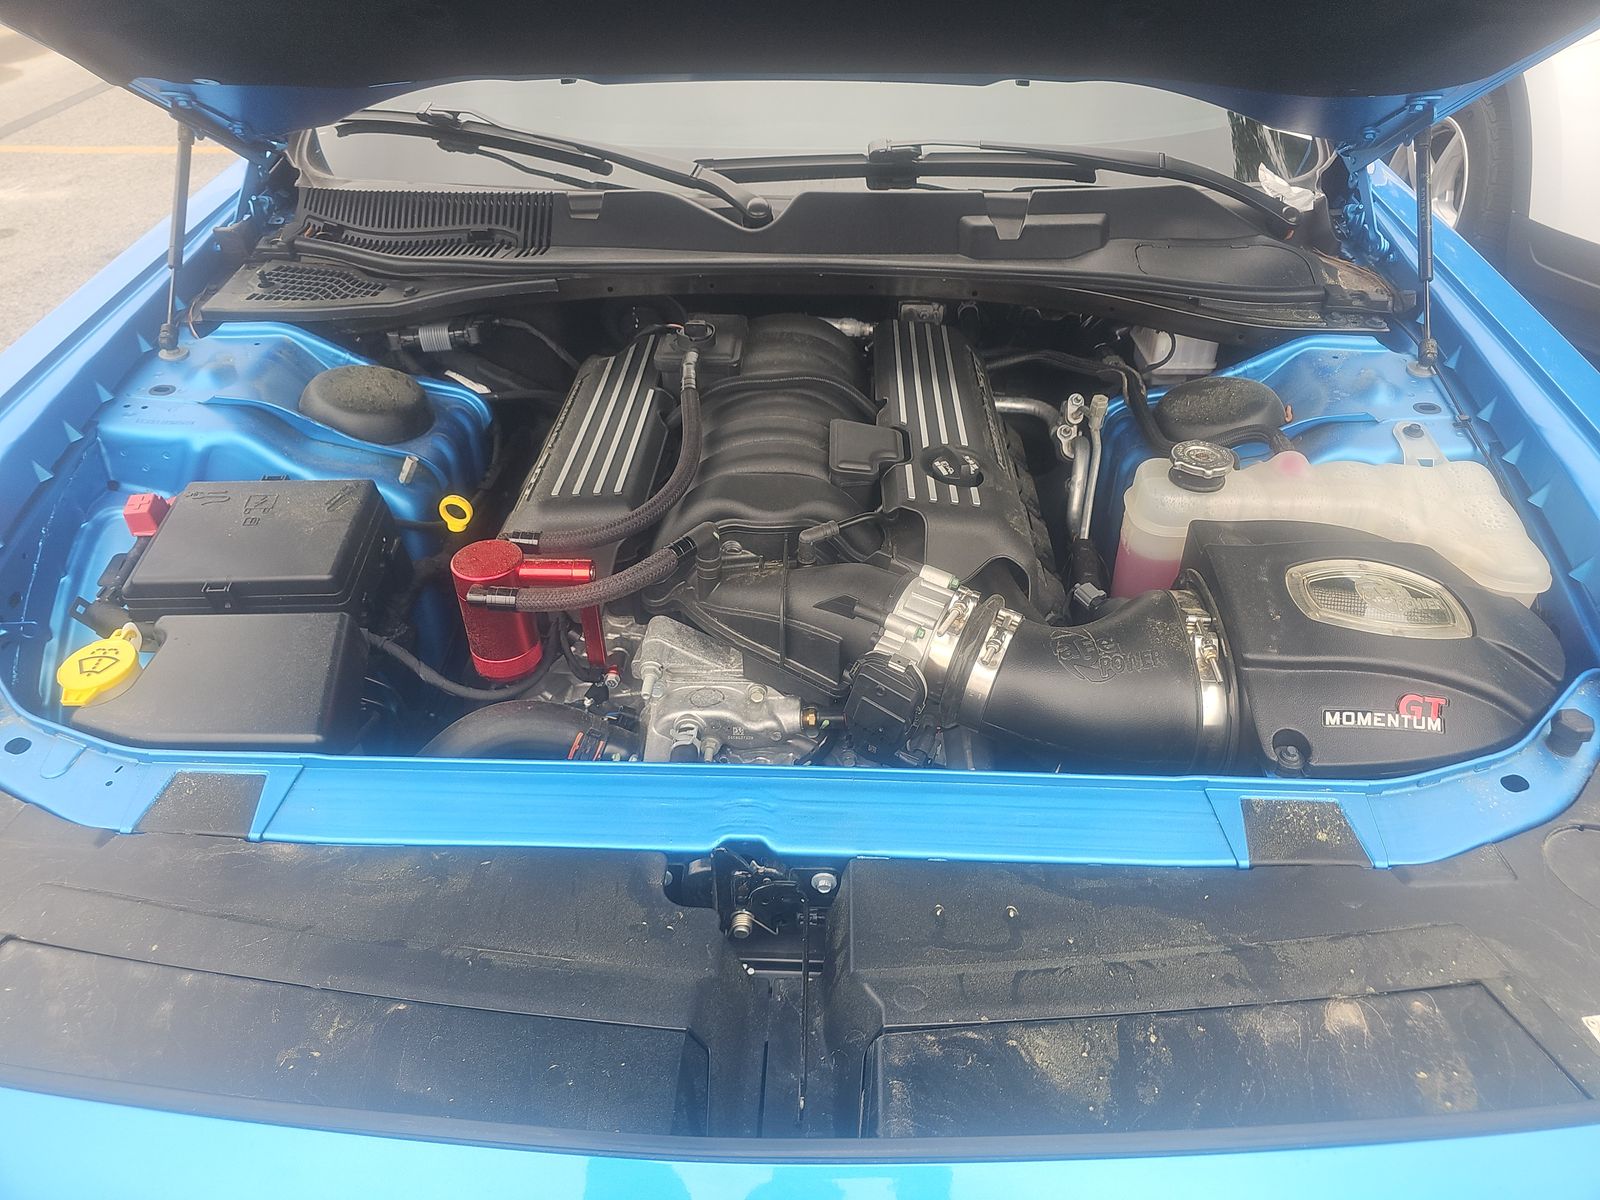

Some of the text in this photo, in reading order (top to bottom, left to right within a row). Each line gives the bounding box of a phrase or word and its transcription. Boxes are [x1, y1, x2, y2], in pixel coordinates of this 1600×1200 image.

[1098, 651, 1169, 678] POWER
[1325, 694, 1447, 732] MOMENTUM GT
